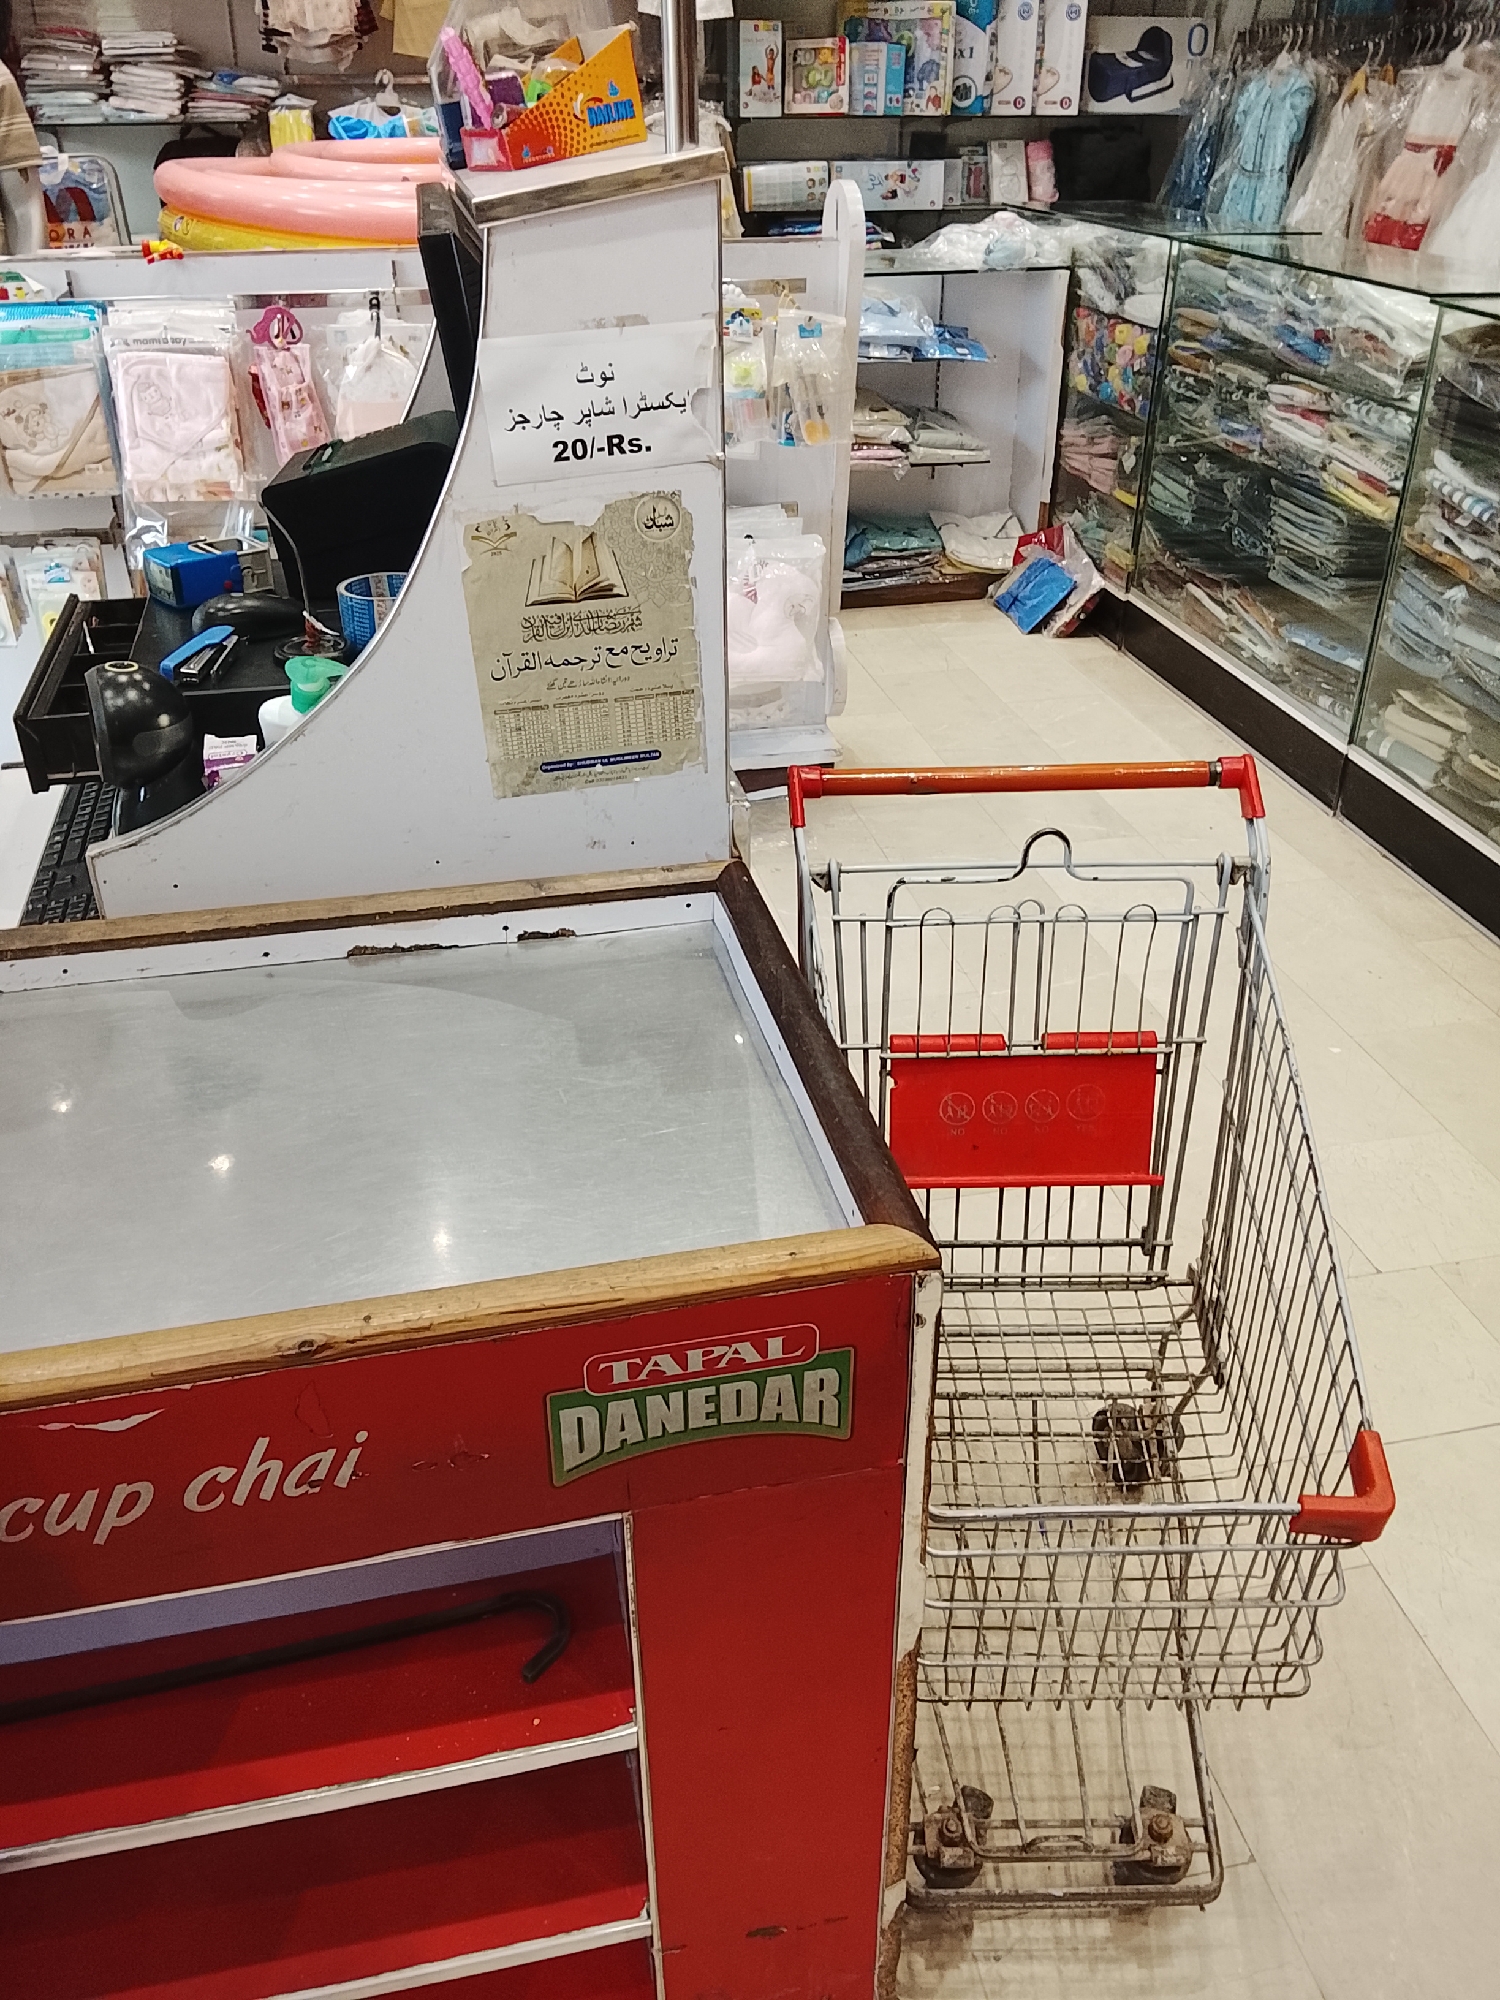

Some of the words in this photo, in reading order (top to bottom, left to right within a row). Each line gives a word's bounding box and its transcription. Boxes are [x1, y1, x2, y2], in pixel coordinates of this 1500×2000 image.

[575, 362, 616, 388] نوٹ
[504, 404, 565, 432] چارجز
[572, 396, 616, 428] شاپر
[552, 434, 652, 463] 20/-Rs.
[490, 651, 542, 682] القرآن
[605, 645, 629, 668] مع
[598, 1336, 806, 1385] TAPAL
[558, 1367, 841, 1472] DANEDAR
[0, 1481, 155, 1545] cup
[183, 1430, 370, 1513] chai
